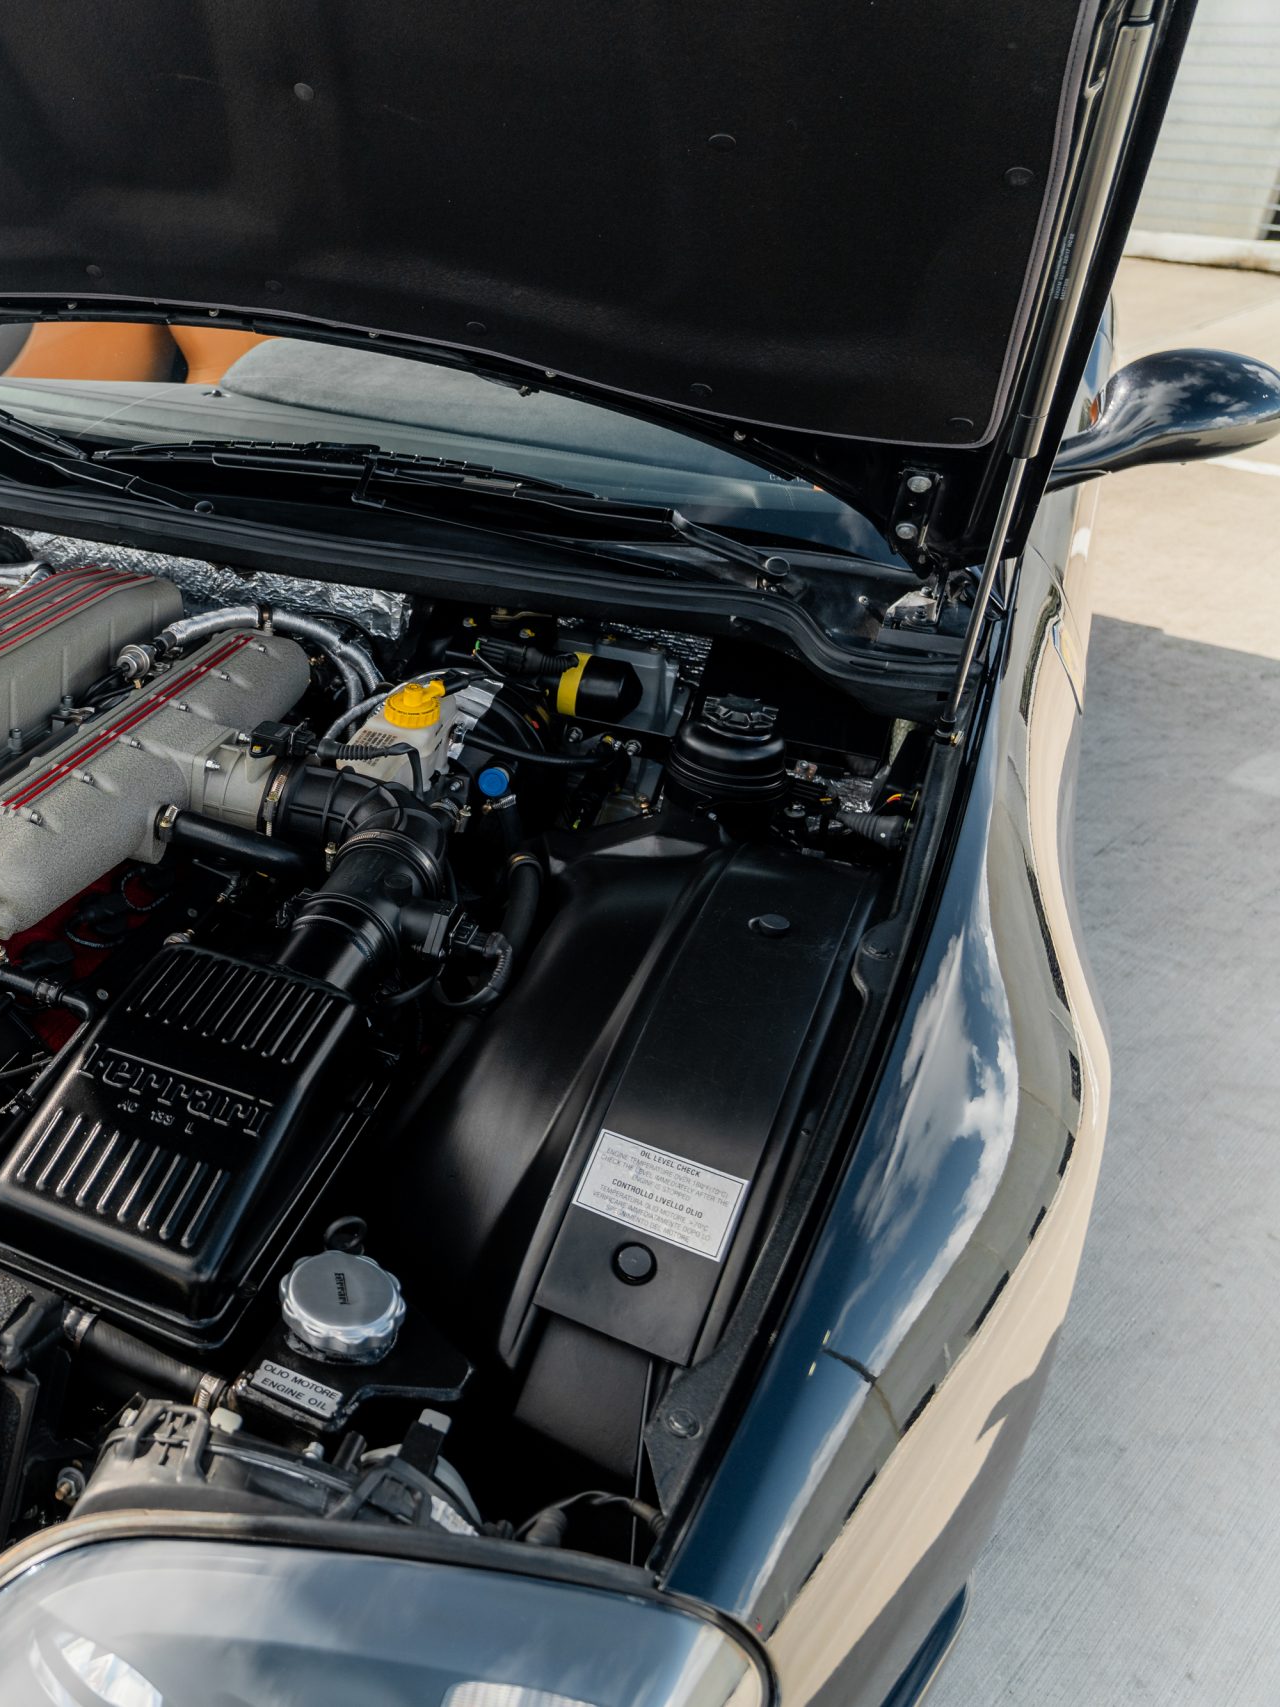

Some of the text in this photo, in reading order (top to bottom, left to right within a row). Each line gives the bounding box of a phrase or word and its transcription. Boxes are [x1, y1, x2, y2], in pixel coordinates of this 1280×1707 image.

[78, 1043, 273, 1137] Ferrari
[639, 1149, 701, 1177] OIL LEVEL CHECK
[611, 1178, 704, 1219] CONTROLLO LIVELLO OLIO
[334, 1272, 351, 1305] Ferrari
[261, 1377, 328, 1411] ENGINE OIL
[263, 1364, 339, 1400] OLIO MOTORE
